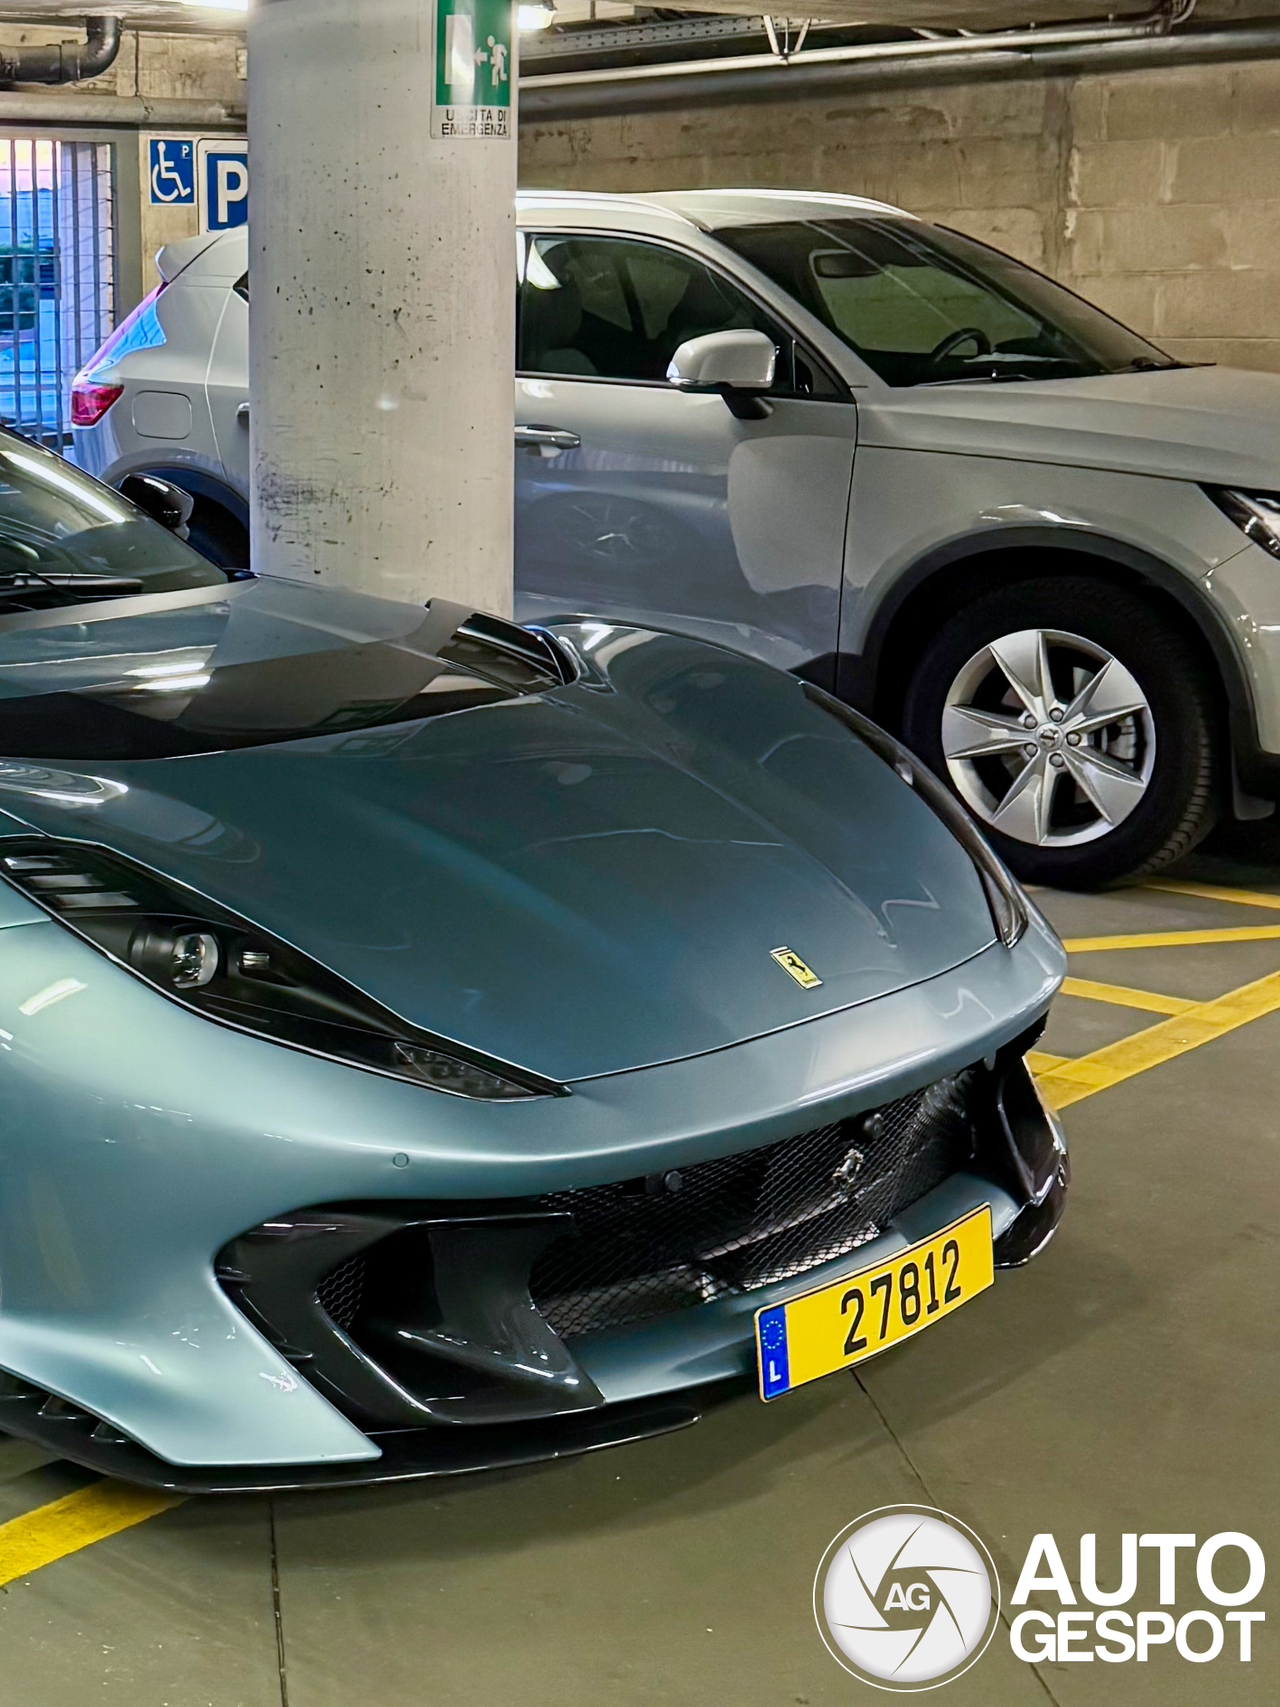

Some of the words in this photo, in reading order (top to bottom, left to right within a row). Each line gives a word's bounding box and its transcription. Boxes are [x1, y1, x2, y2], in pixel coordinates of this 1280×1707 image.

[446, 109, 493, 121] UCITA
[497, 109, 507, 122] DI
[441, 122, 508, 136] EMERGENZA
[182, 145, 190, 158] P
[217, 160, 248, 223] P
[769, 1360, 782, 1382] L
[840, 1239, 962, 1356] 27812
